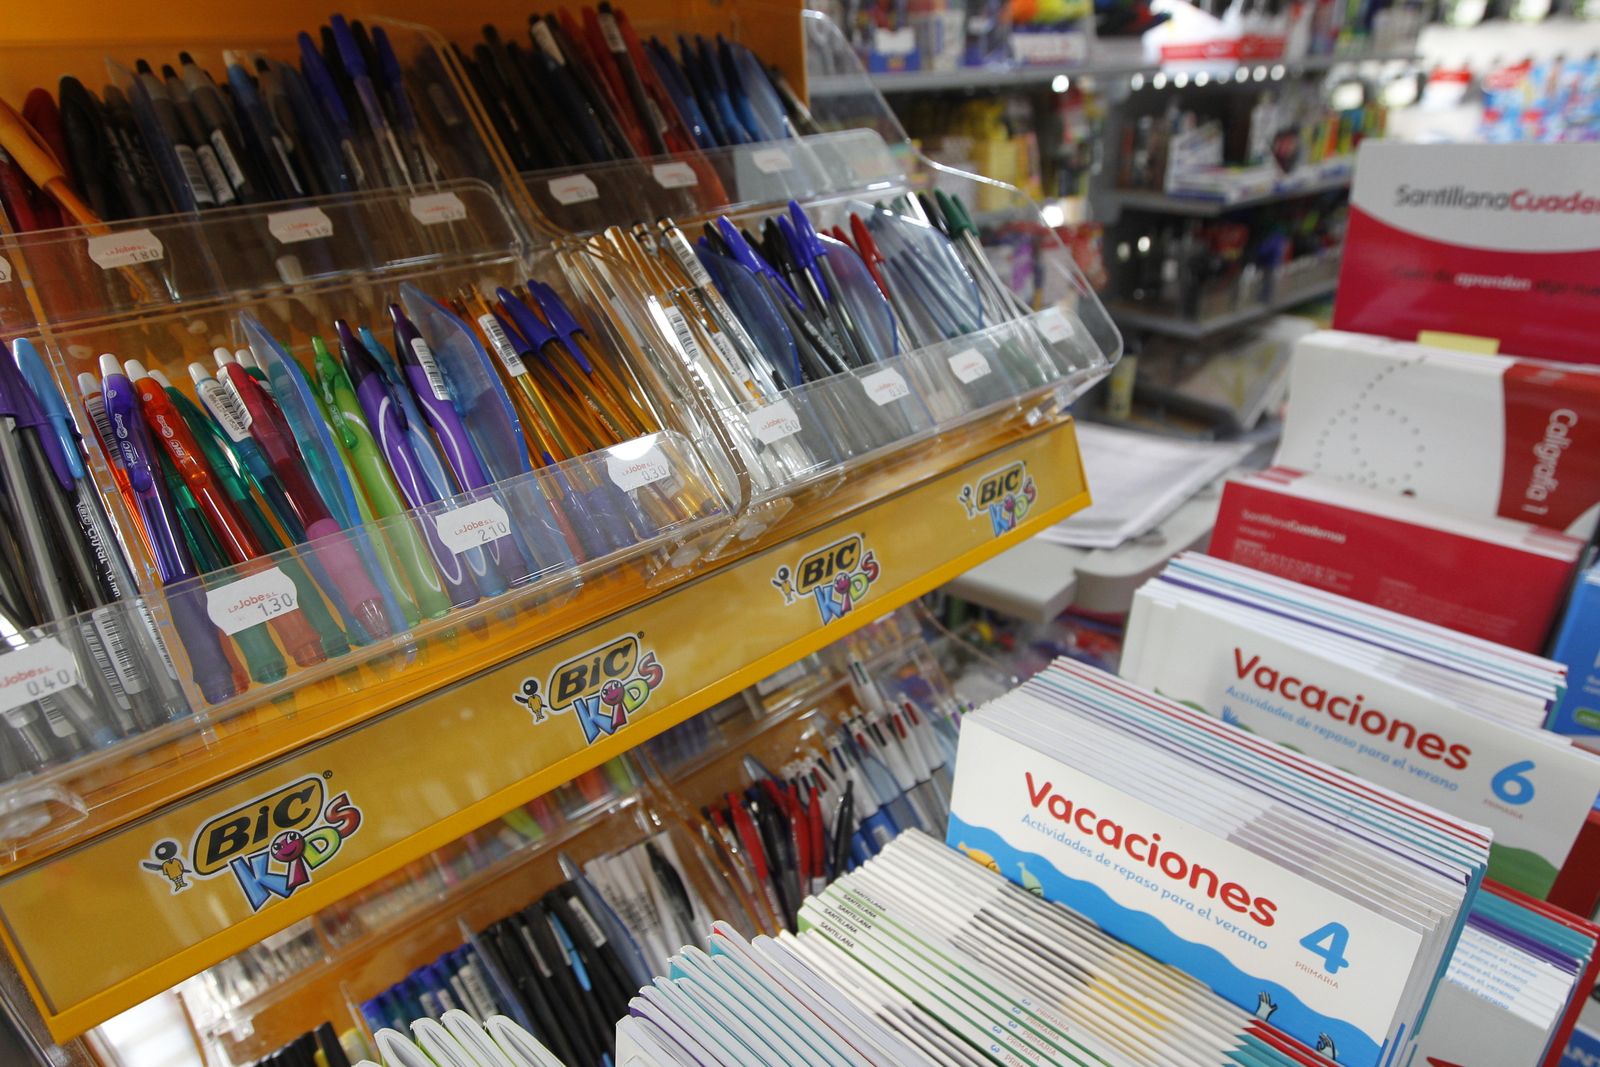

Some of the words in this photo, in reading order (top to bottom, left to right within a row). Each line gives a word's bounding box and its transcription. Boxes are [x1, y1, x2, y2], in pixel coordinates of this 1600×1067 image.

[1522, 504, 1549, 515] 1
[478, 522, 507, 542] 2.10
[257, 592, 293, 617] 1.30
[26, 669, 71, 696] 0.40
[1234, 648, 1473, 771] Vacaciones
[1225, 685, 1294, 722] Actividades
[1296, 714, 1312, 729] de
[1357, 742, 1391, 763] para
[1392, 756, 1407, 770] el
[1408, 765, 1459, 792] verano
[1490, 760, 1536, 806] 6
[1025, 772, 1278, 928] Vacaciones
[1021, 813, 1093, 859] Actividades
[1095, 852, 1111, 868] de
[1113, 862, 1160, 893] repaso
[1160, 888, 1194, 912] para
[1197, 905, 1212, 921] el
[1216, 919, 1268, 950] verano
[838, 904, 872, 930] SANTILLANA
[843, 894, 877, 918] SANTILLANA
[820, 921, 855, 948] SANTILLANA
[823, 908, 858, 934] SANTILLANA
[1299, 922, 1349, 974] 4
[1295, 961, 1339, 989] PRIMARIA
[1022, 1030, 1056, 1056] PRIMARIA
